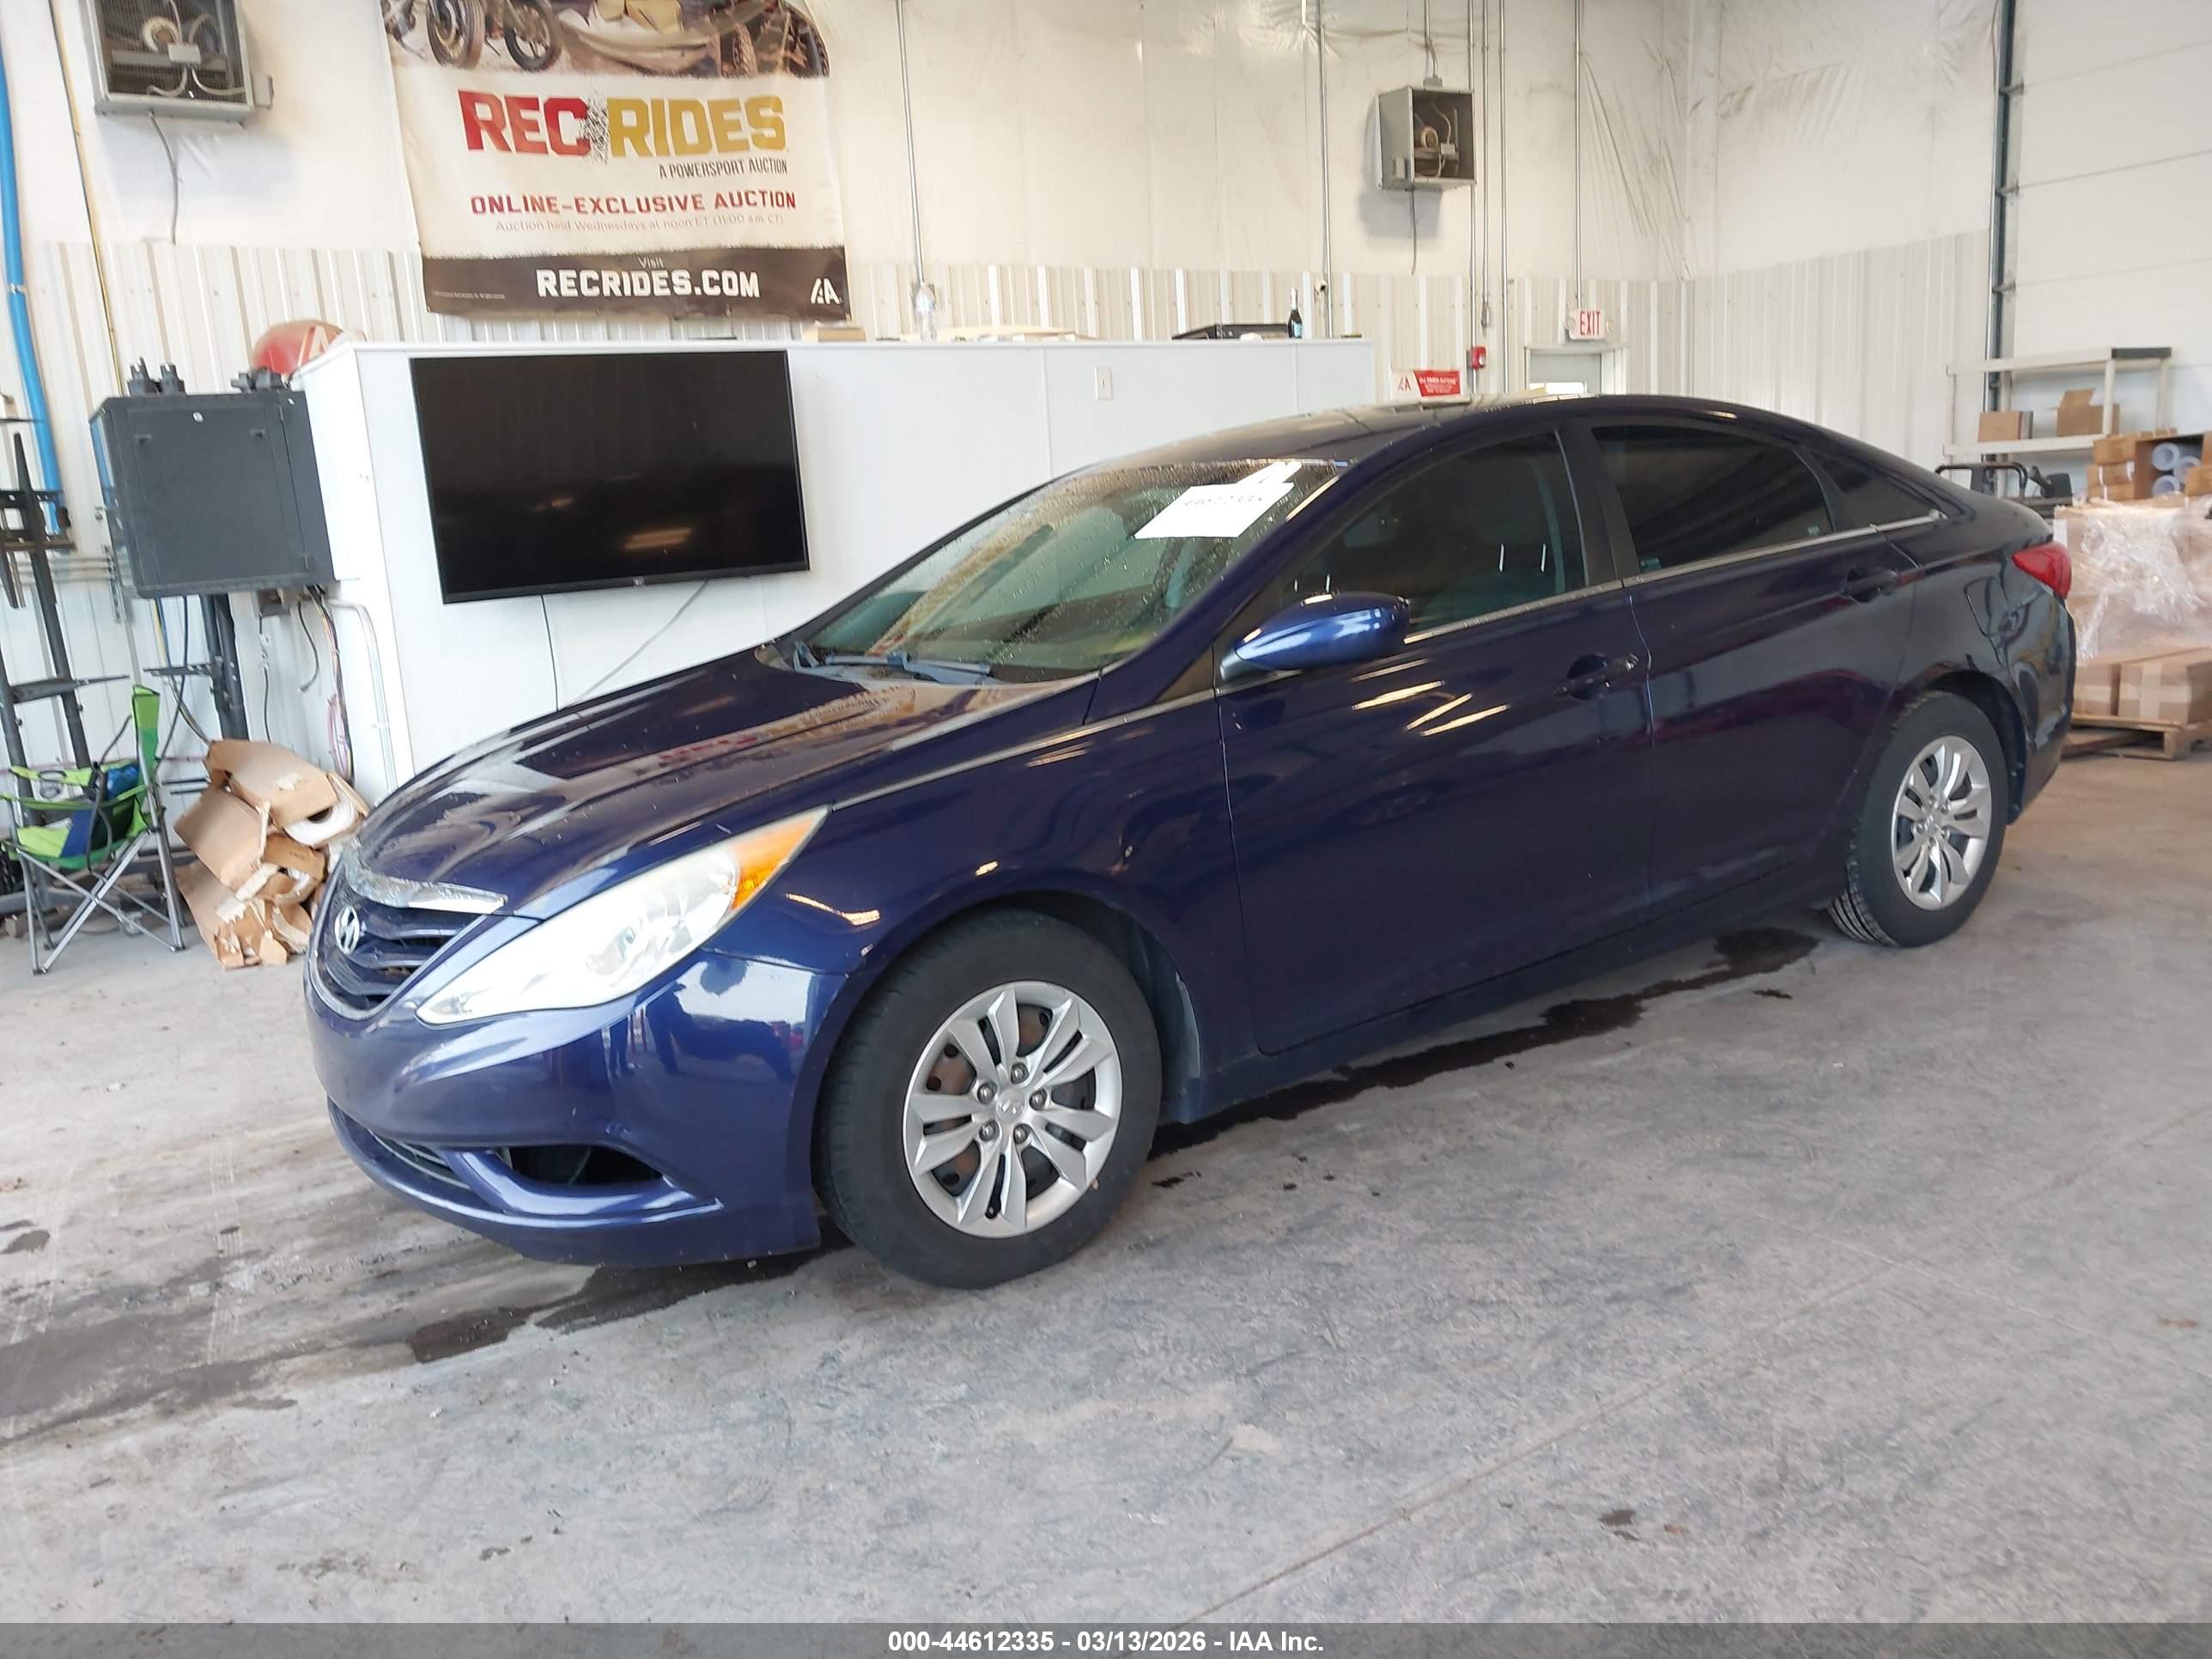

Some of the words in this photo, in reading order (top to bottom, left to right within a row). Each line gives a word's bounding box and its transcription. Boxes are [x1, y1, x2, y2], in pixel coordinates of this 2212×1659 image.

[458, 89, 591, 156] REC
[606, 95, 787, 158] RIDES
[659, 164, 667, 179] A
[668, 160, 744, 179] POWERSPORT
[748, 157, 788, 175] AUCTION
[471, 193, 705, 215] ONLINE-EXCLUSIVE
[714, 190, 797, 209] AUCTION
[496, 220, 544, 232] Auction
[547, 220, 572, 231] held
[574, 219, 647, 231] Wednesdays
[649, 219, 659, 229] at
[663, 218, 692, 228] noon
[695, 216, 708, 227] ET
[637, 256, 665, 269] Visit
[536, 269, 761, 299] RECRIDES.COM
[1580, 310, 1601, 336] EXIT
